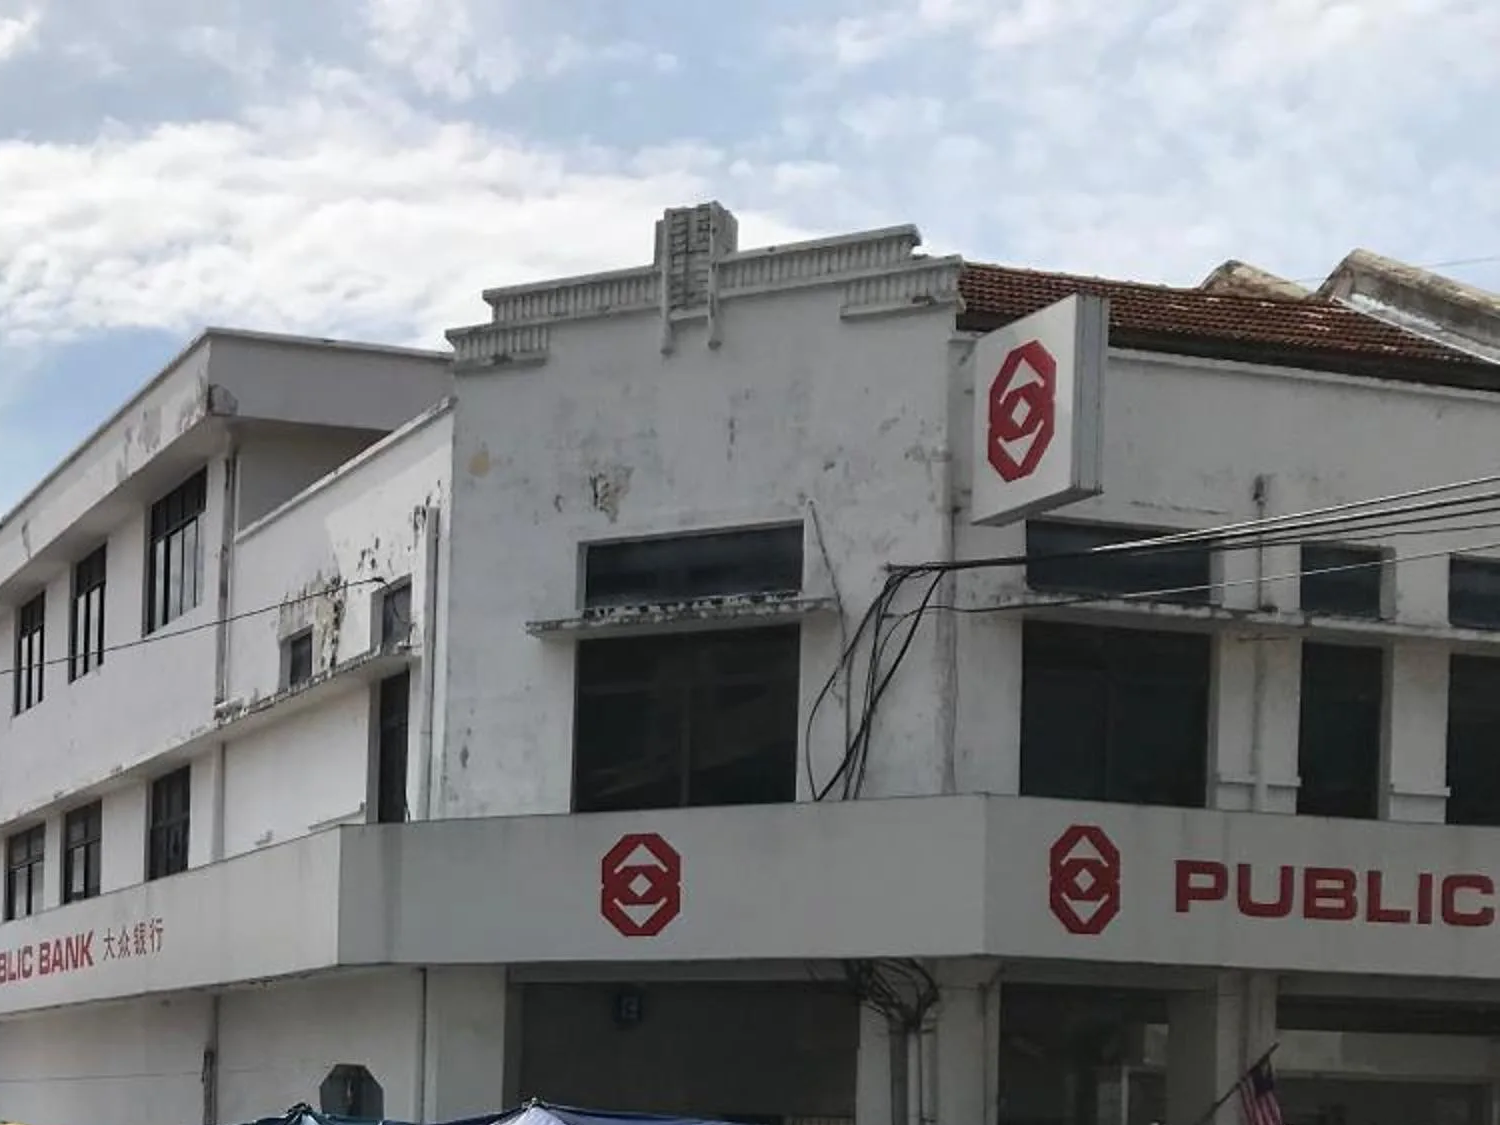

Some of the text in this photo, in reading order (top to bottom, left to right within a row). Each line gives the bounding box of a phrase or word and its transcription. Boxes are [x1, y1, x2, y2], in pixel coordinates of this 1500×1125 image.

[1175, 859, 1494, 927] PUBLIC
[39, 930, 94, 975] BANK
[103, 918, 164, 961] 大众银行
